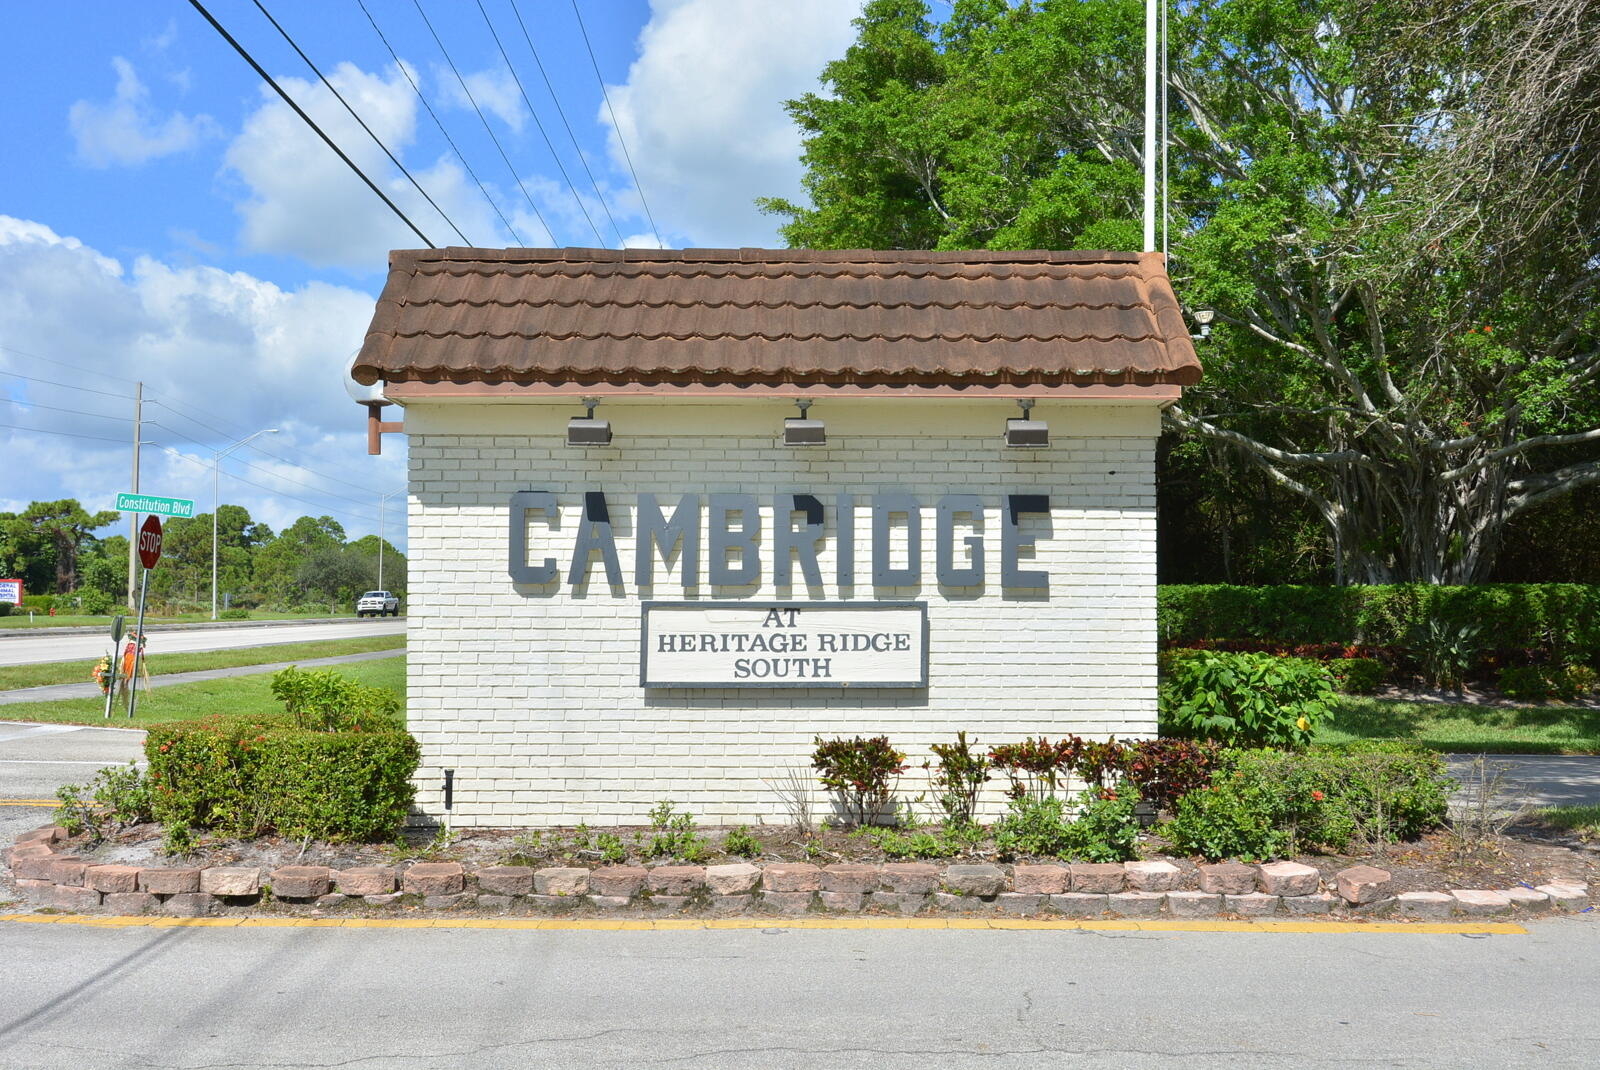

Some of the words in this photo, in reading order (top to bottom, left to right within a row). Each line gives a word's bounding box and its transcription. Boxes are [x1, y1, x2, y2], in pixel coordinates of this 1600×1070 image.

[119, 496, 170, 513] Constitution
[172, 501, 191, 515] Blvd
[140, 530, 161, 553] STOP
[509, 490, 1050, 587] CAMBRIDGE
[762, 608, 801, 628] AT
[657, 633, 808, 653] HERITAGE
[817, 633, 911, 653] RIDGE
[734, 658, 832, 679] SOUTH
